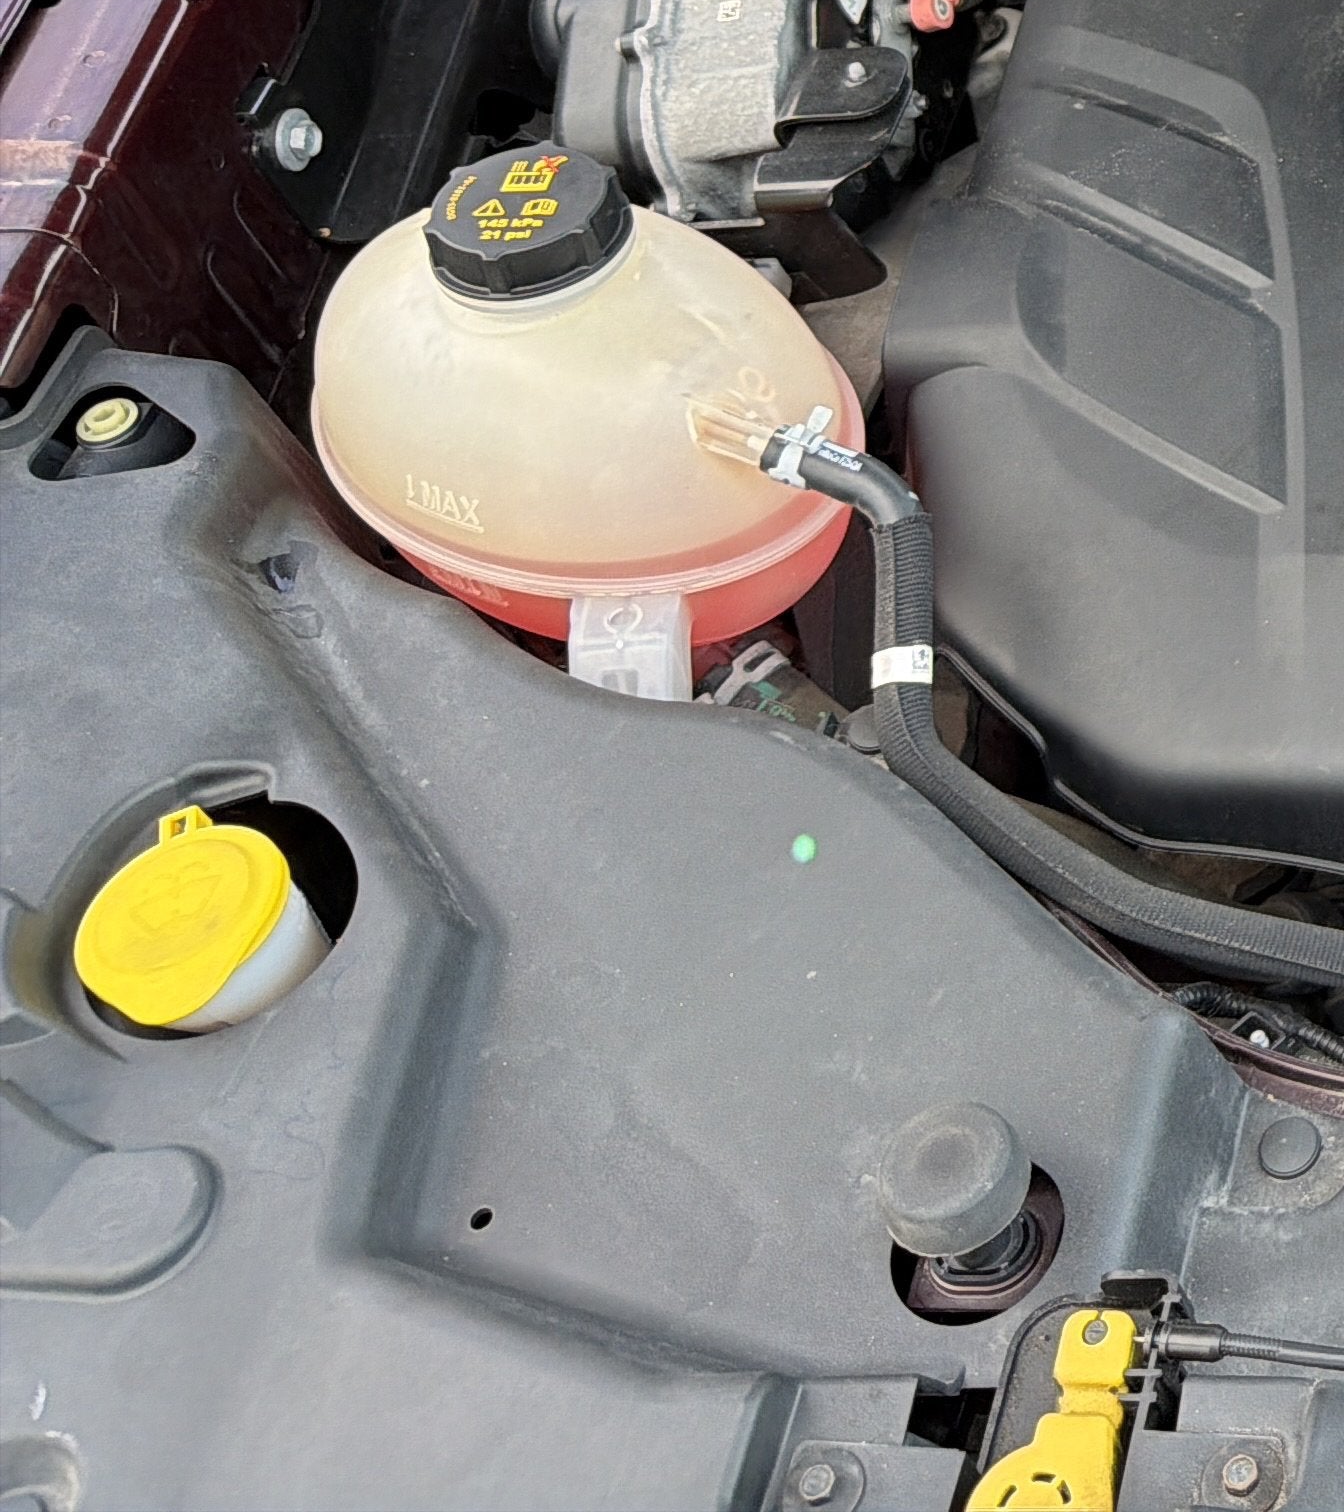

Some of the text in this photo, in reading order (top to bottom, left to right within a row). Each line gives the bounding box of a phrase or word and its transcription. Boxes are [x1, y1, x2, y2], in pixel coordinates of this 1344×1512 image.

[510, 218, 544, 228] kPa
[479, 229, 532, 241] 21 psi
[420, 480, 480, 526] MAX
